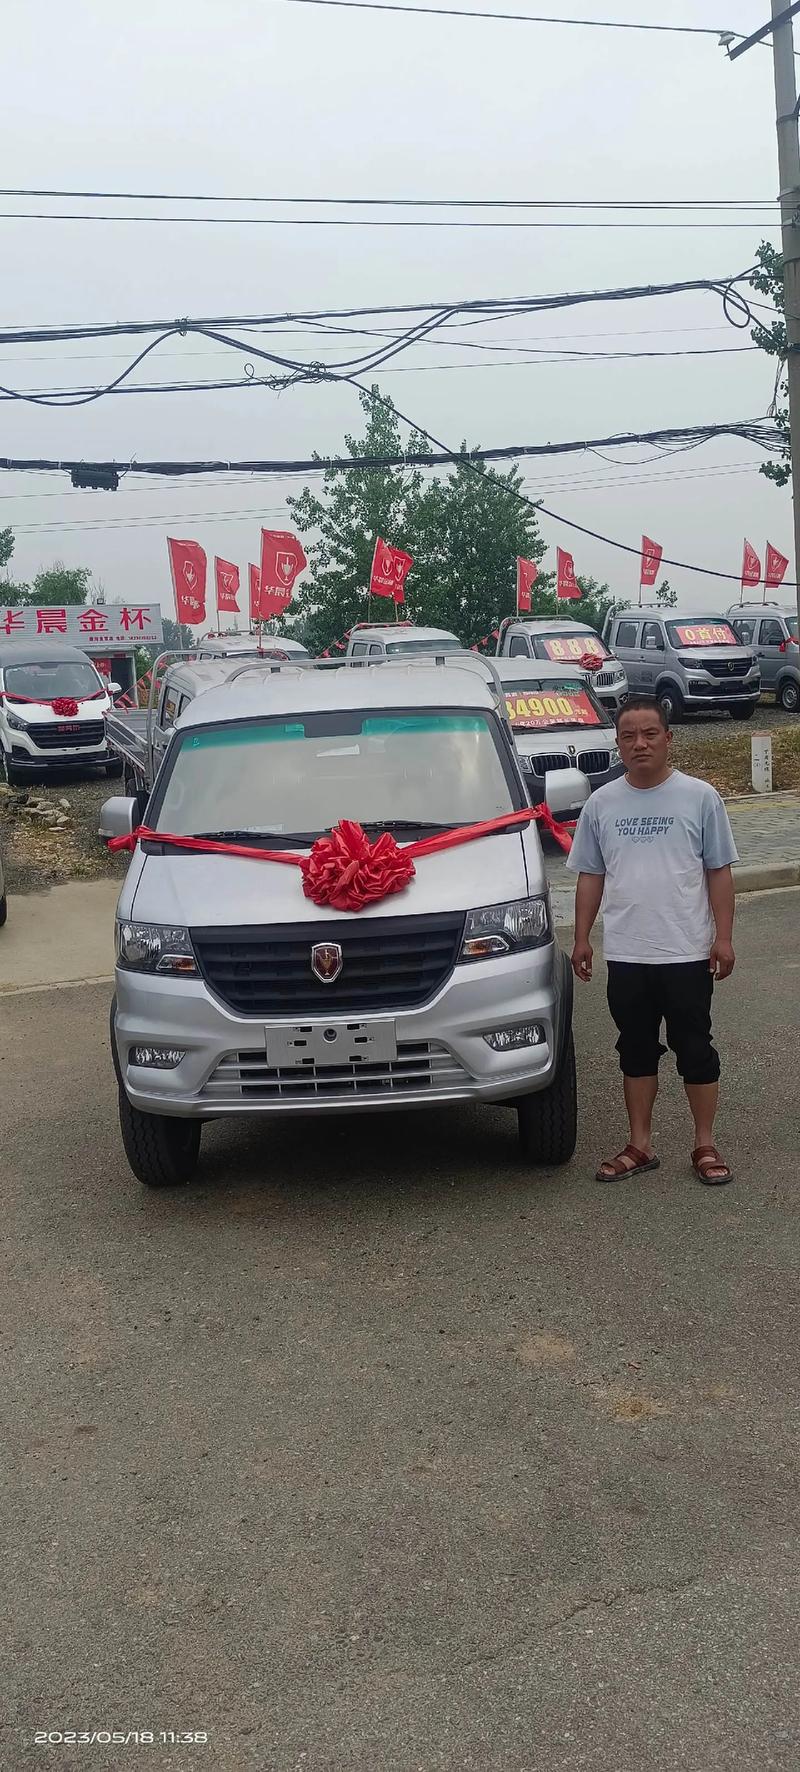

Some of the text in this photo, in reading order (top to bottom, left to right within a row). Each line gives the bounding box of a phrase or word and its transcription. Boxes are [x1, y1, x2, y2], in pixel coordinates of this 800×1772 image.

[0, 608, 152, 635] 华晨金杯
[684, 628, 728, 641] 0首付
[615, 816, 674, 828] LOVE SEEING
[618, 826, 670, 836] YOU HAPPY
